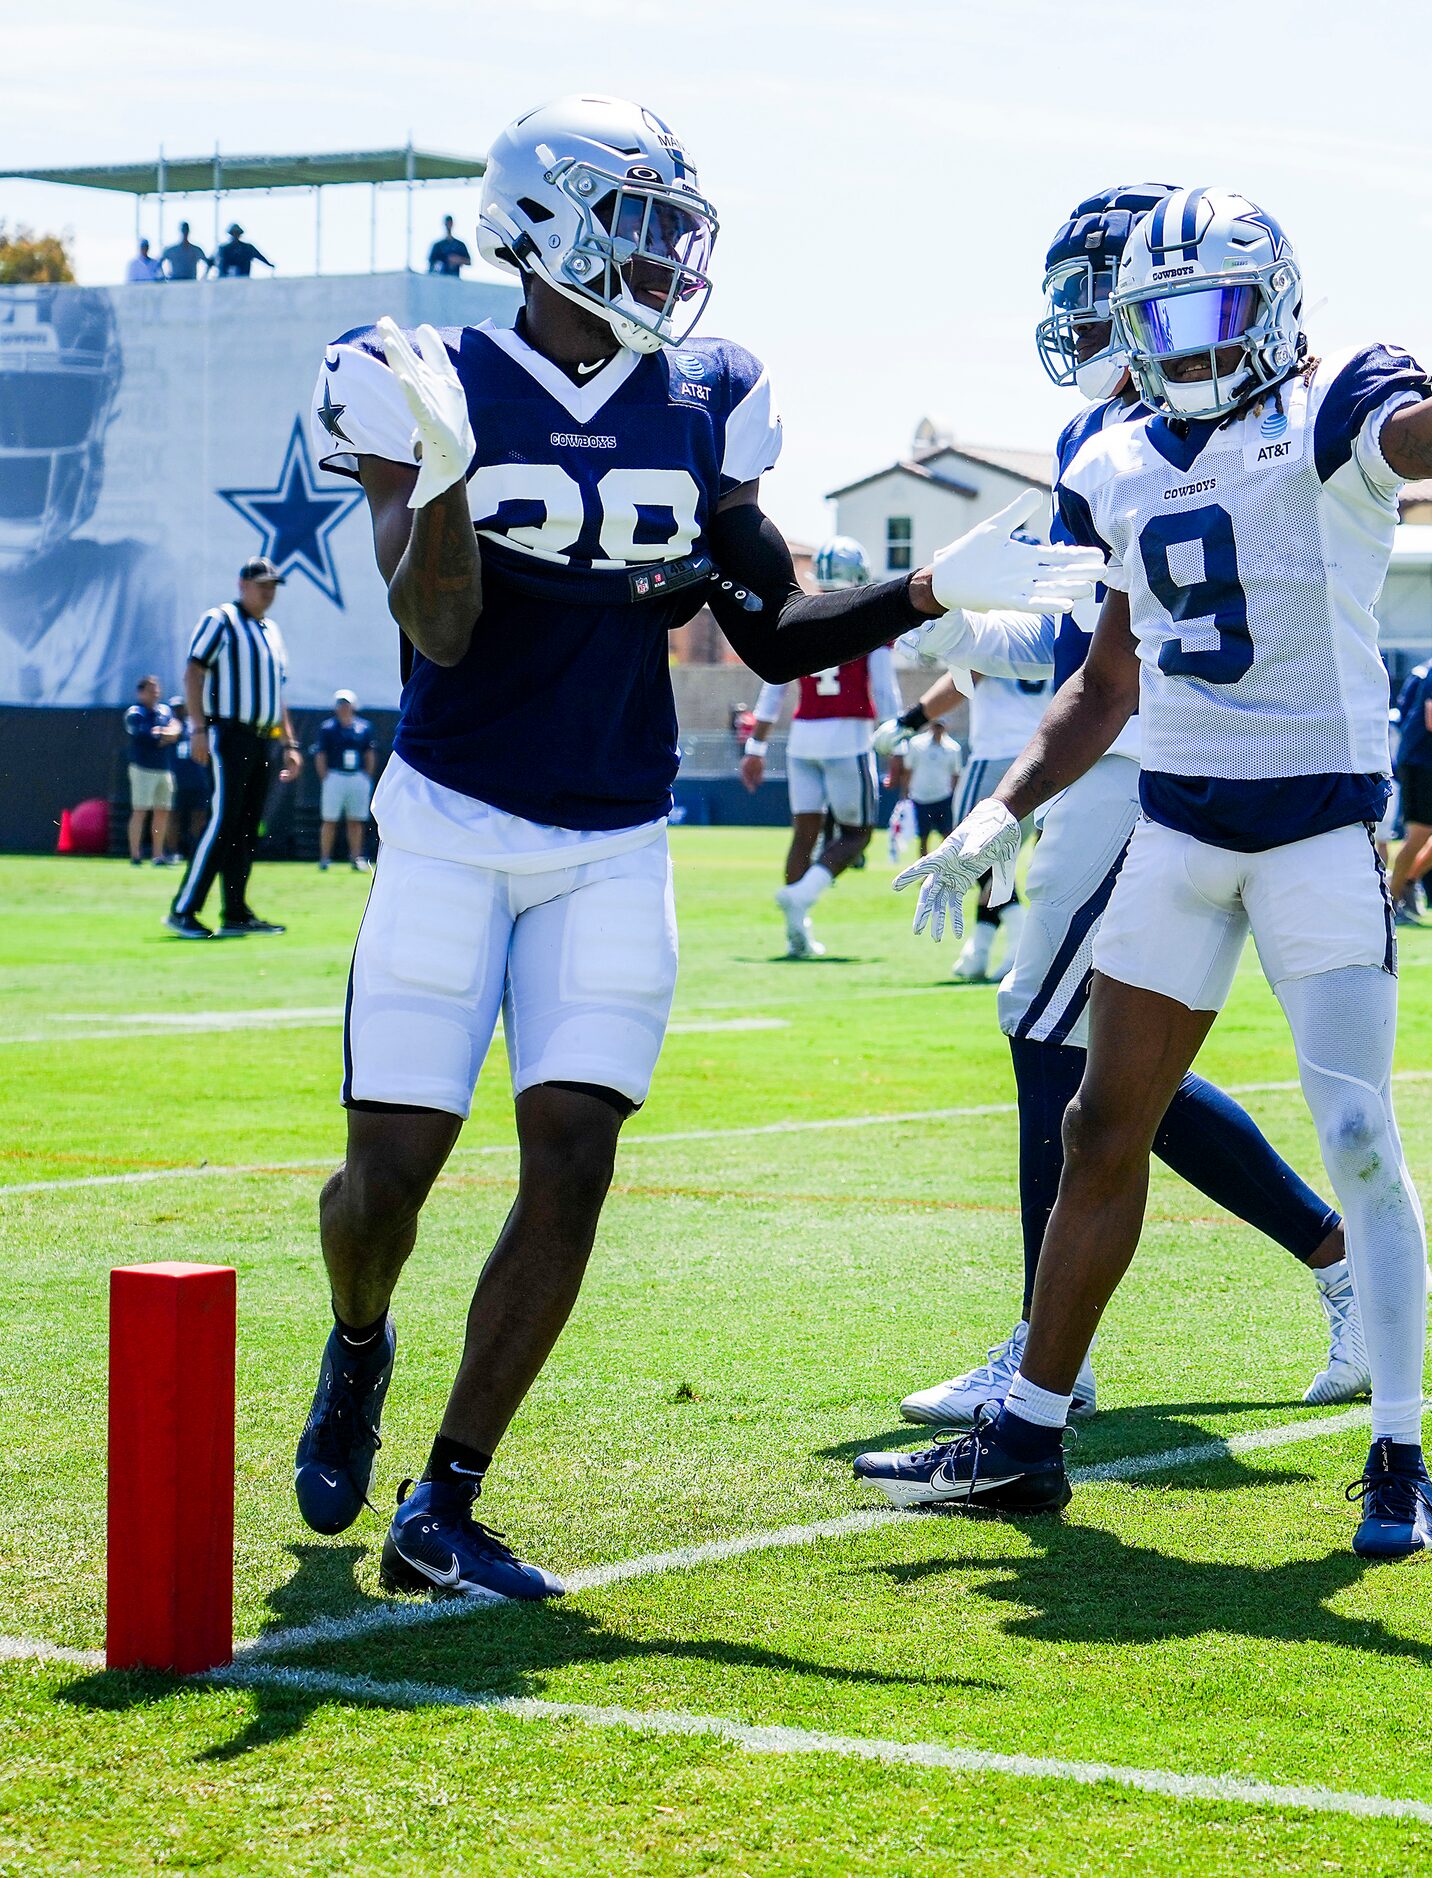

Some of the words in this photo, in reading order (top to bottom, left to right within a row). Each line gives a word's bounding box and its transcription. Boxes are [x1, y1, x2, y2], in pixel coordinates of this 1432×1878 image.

[1152, 266, 1194, 280] COWBOYS
[681, 382, 711, 401] AT&T
[550, 433, 617, 448] COWBOYS
[1257, 441, 1292, 461] AT&T
[1164, 478, 1217, 499] COWBOYS
[1138, 503, 1255, 685] 9
